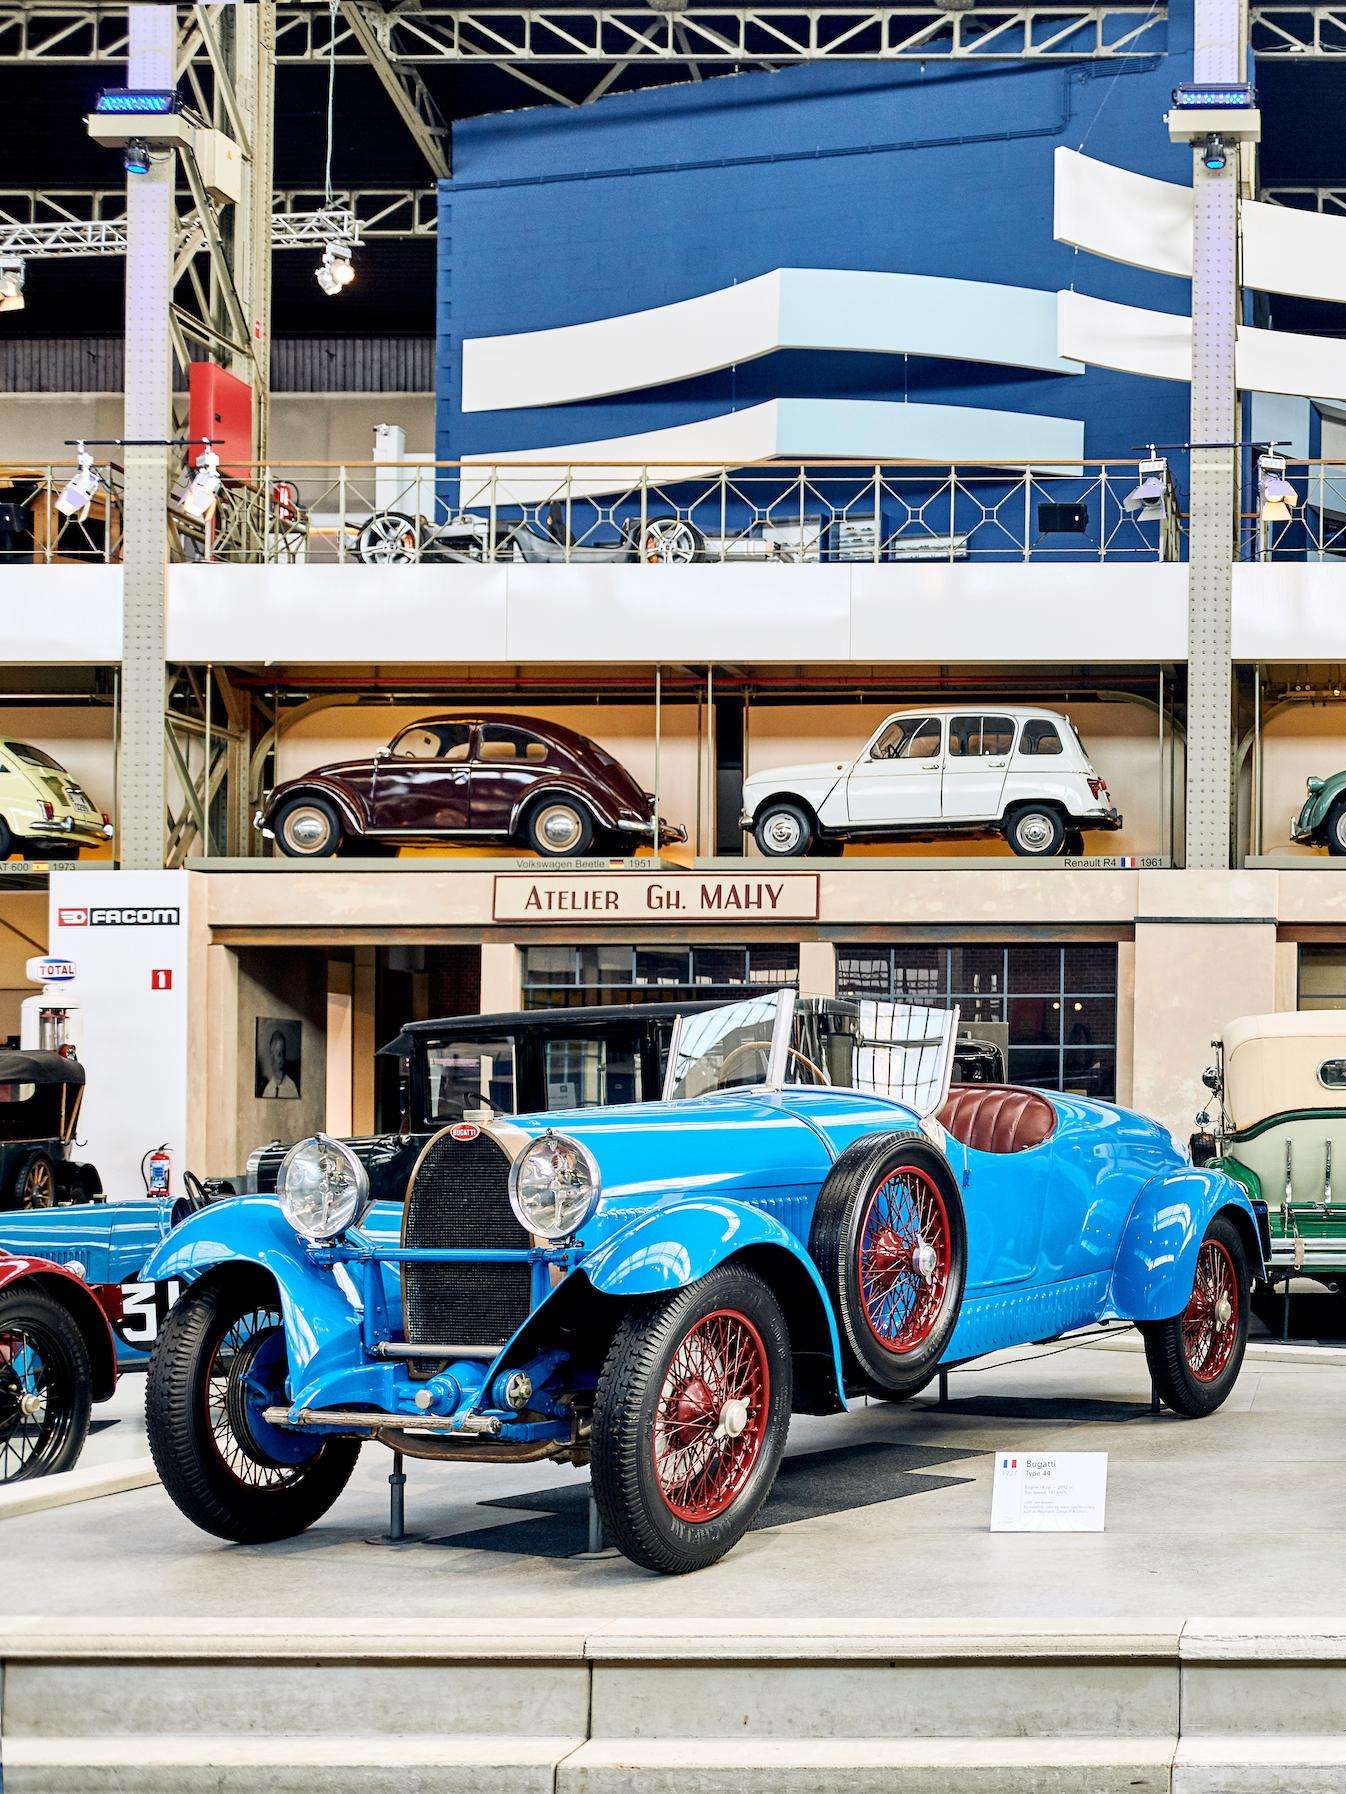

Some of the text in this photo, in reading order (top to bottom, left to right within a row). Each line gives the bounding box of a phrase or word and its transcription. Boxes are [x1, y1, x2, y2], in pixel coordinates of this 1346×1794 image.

[11, 863, 29, 871] 600
[53, 863, 76, 871] 1973
[516, 859, 651, 870] Volkswagen Beetle 1951
[1064, 858, 1162, 868] Renault R4 1961
[700, 884, 784, 910] MAHY
[91, 909, 179, 924] FACOM
[39, 964, 75, 976] TOTAL
[156, 970, 167, 989] 1
[1026, 1459, 1057, 1470] Bugatti
[1026, 1470, 1041, 1478] Type
